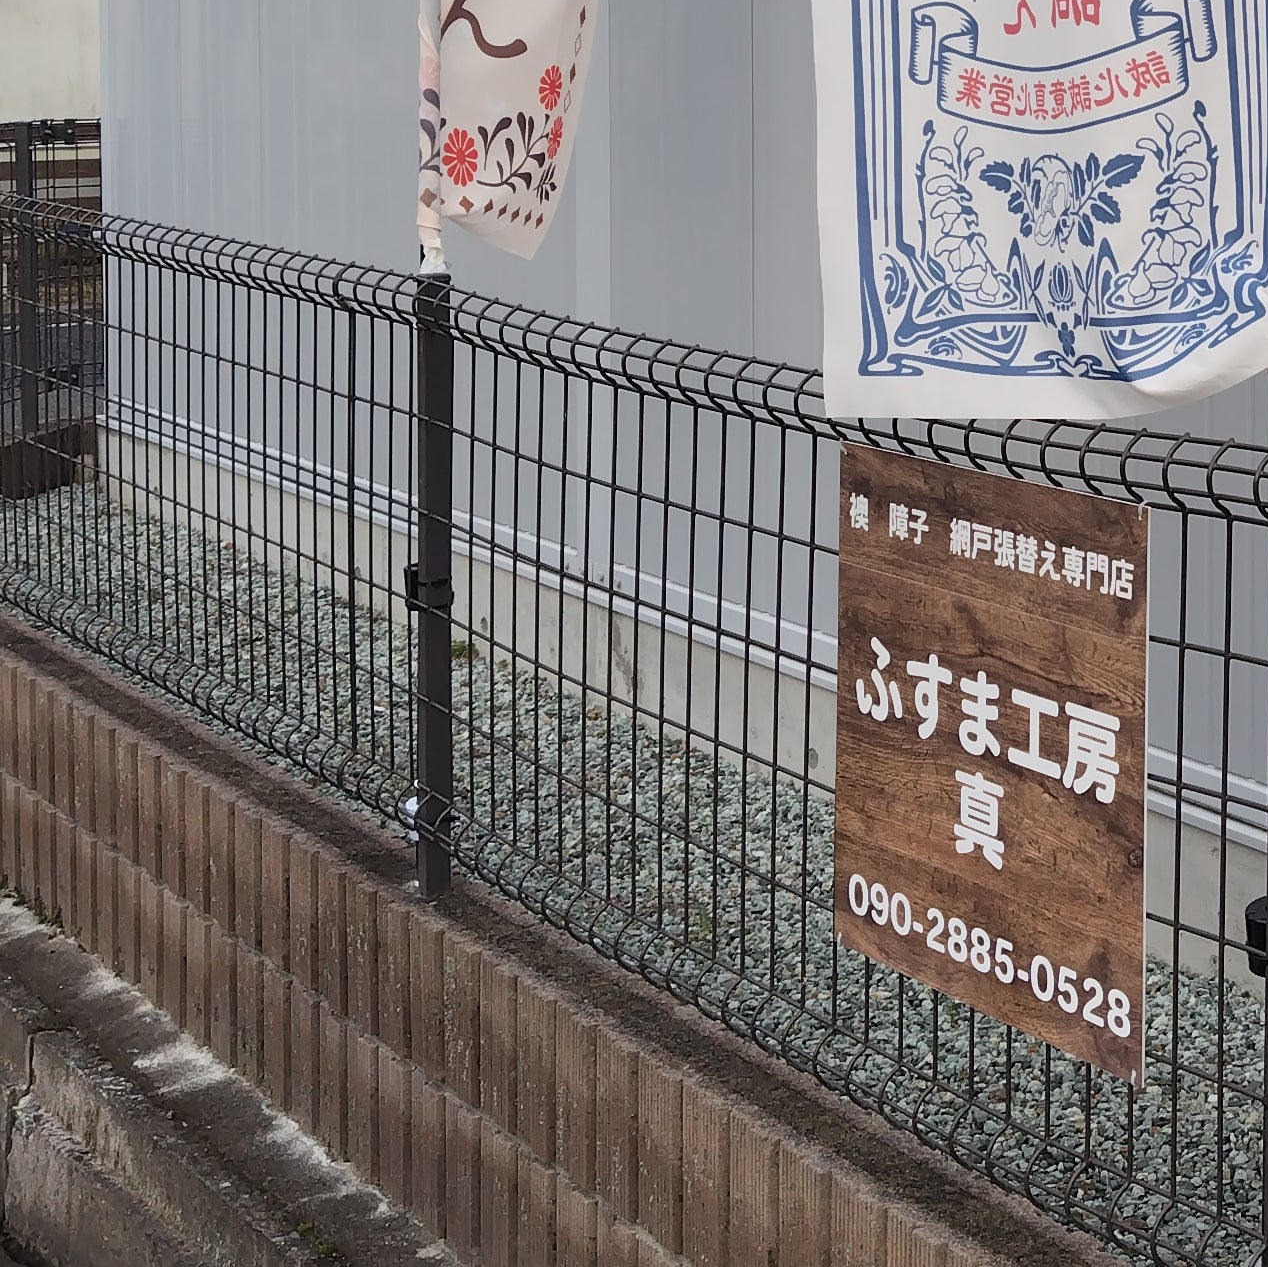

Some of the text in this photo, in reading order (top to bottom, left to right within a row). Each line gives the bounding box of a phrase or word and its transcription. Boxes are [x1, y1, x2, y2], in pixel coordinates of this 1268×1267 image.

[849, 492, 1135, 601] 襖 障子 網戸張替え専門店
[855, 636, 1121, 806] ふすま工房
[953, 769, 1005, 871] 真
[848, 873, 1131, 1039] 090-2885-0528
